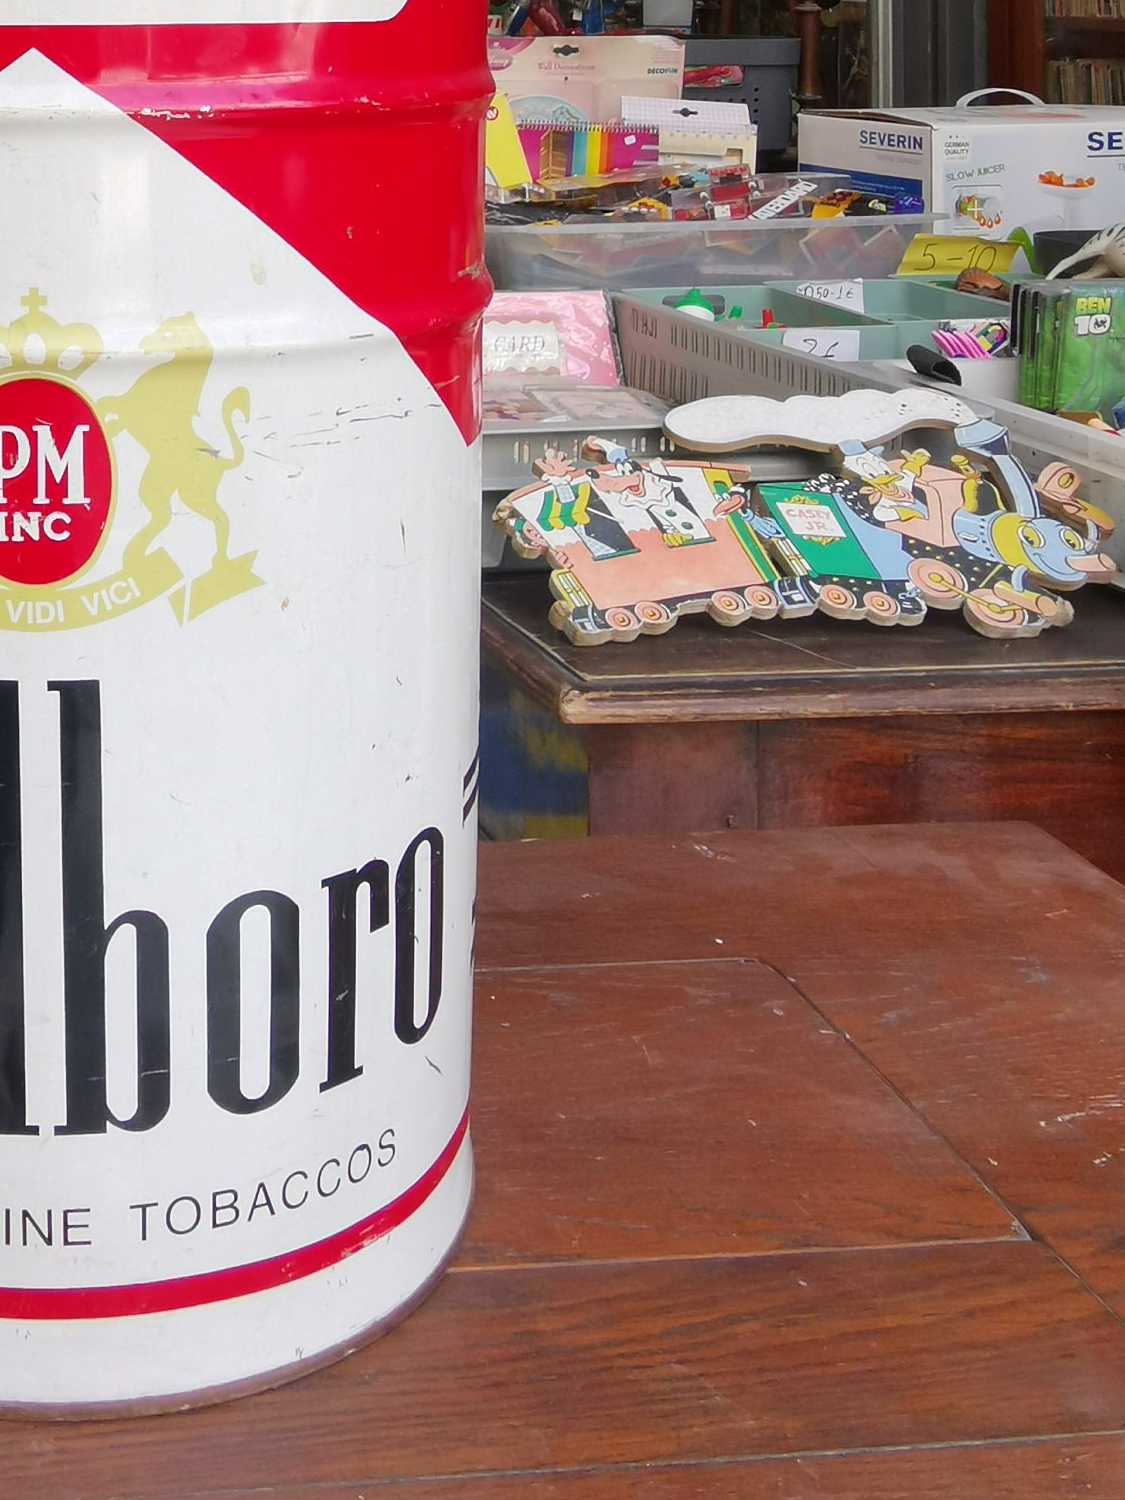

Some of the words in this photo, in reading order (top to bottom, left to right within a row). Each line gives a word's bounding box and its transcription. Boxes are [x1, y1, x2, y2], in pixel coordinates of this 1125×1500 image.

[859, 129, 923, 151] SEVERIN
[944, 141, 970, 149] GERMAN
[946, 169, 975, 182] SLOW
[977, 164, 1006, 178] JUICER
[1075, 296, 1112, 314] BEN
[1074, 313, 1111, 336] 10
[494, 335, 546, 351] CARD
[785, 508, 830, 520] CASEY
[6, 600, 65, 625] VIDI
[80, 576, 142, 618] VICI
[129, 1129, 397, 1243] TOBACCOS
